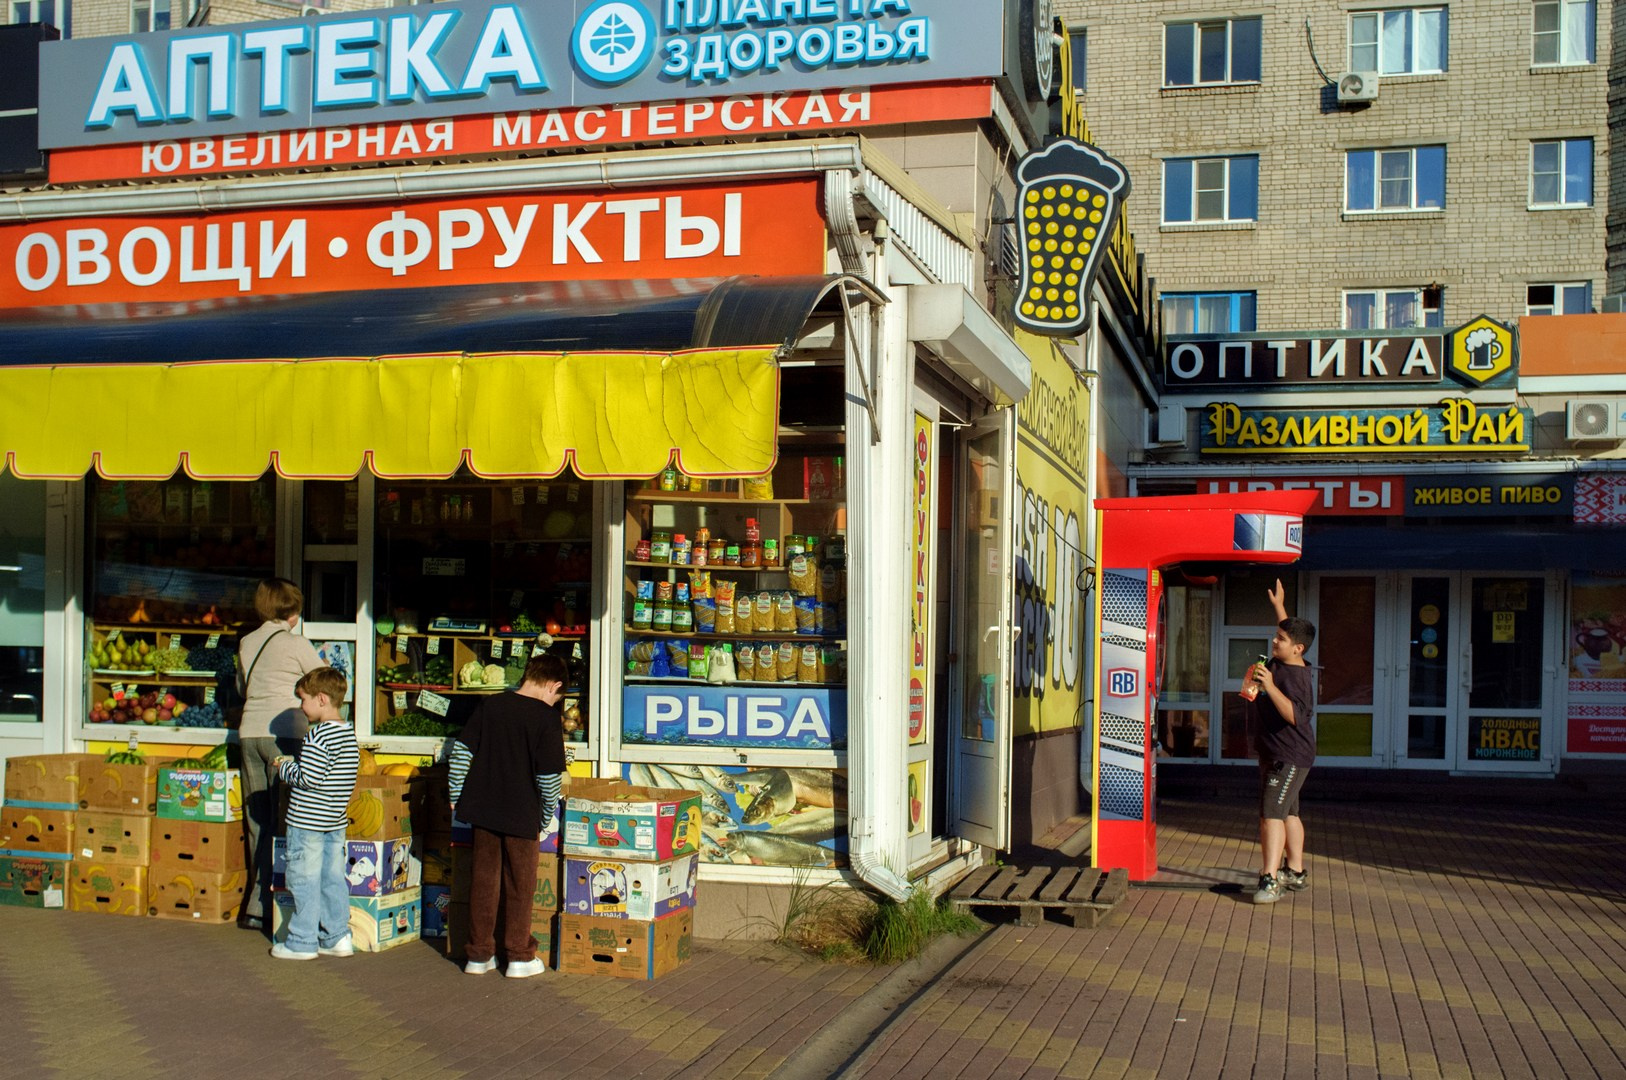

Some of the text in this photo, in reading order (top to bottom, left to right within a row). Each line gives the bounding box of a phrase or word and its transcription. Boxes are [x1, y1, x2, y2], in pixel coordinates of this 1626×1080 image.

[665, 0, 912, 31] ПЛАН
[85, 4, 548, 129] АПТЕКА
[662, 16, 930, 81] ЗДОРОВЬЯ
[141, 85, 872, 174] ЮВЕЛИРНАЯ МАСТЕРСКАЯ
[15, 193, 742, 291] ОВОЩИ ФРУКТЫ
[1171, 337, 1437, 379] ОПТИКА
[1207, 397, 1525, 447] РАЗЛИВНОЙ РАЙ
[1414, 486, 1562, 505] ЖИВОЕ ПИВО
[914, 428, 928, 668] ФРУКТЫ
[1112, 672, 1135, 693] RB
[645, 695, 830, 738] РЫБА
[1481, 719, 1539, 729] ХОЛОДНЫЙ
[1588, 724, 1626, 734] Доступн
[1475, 748, 1536, 758] МОРОЖЕНОЕ
[1480, 729, 1539, 749] КВАС
